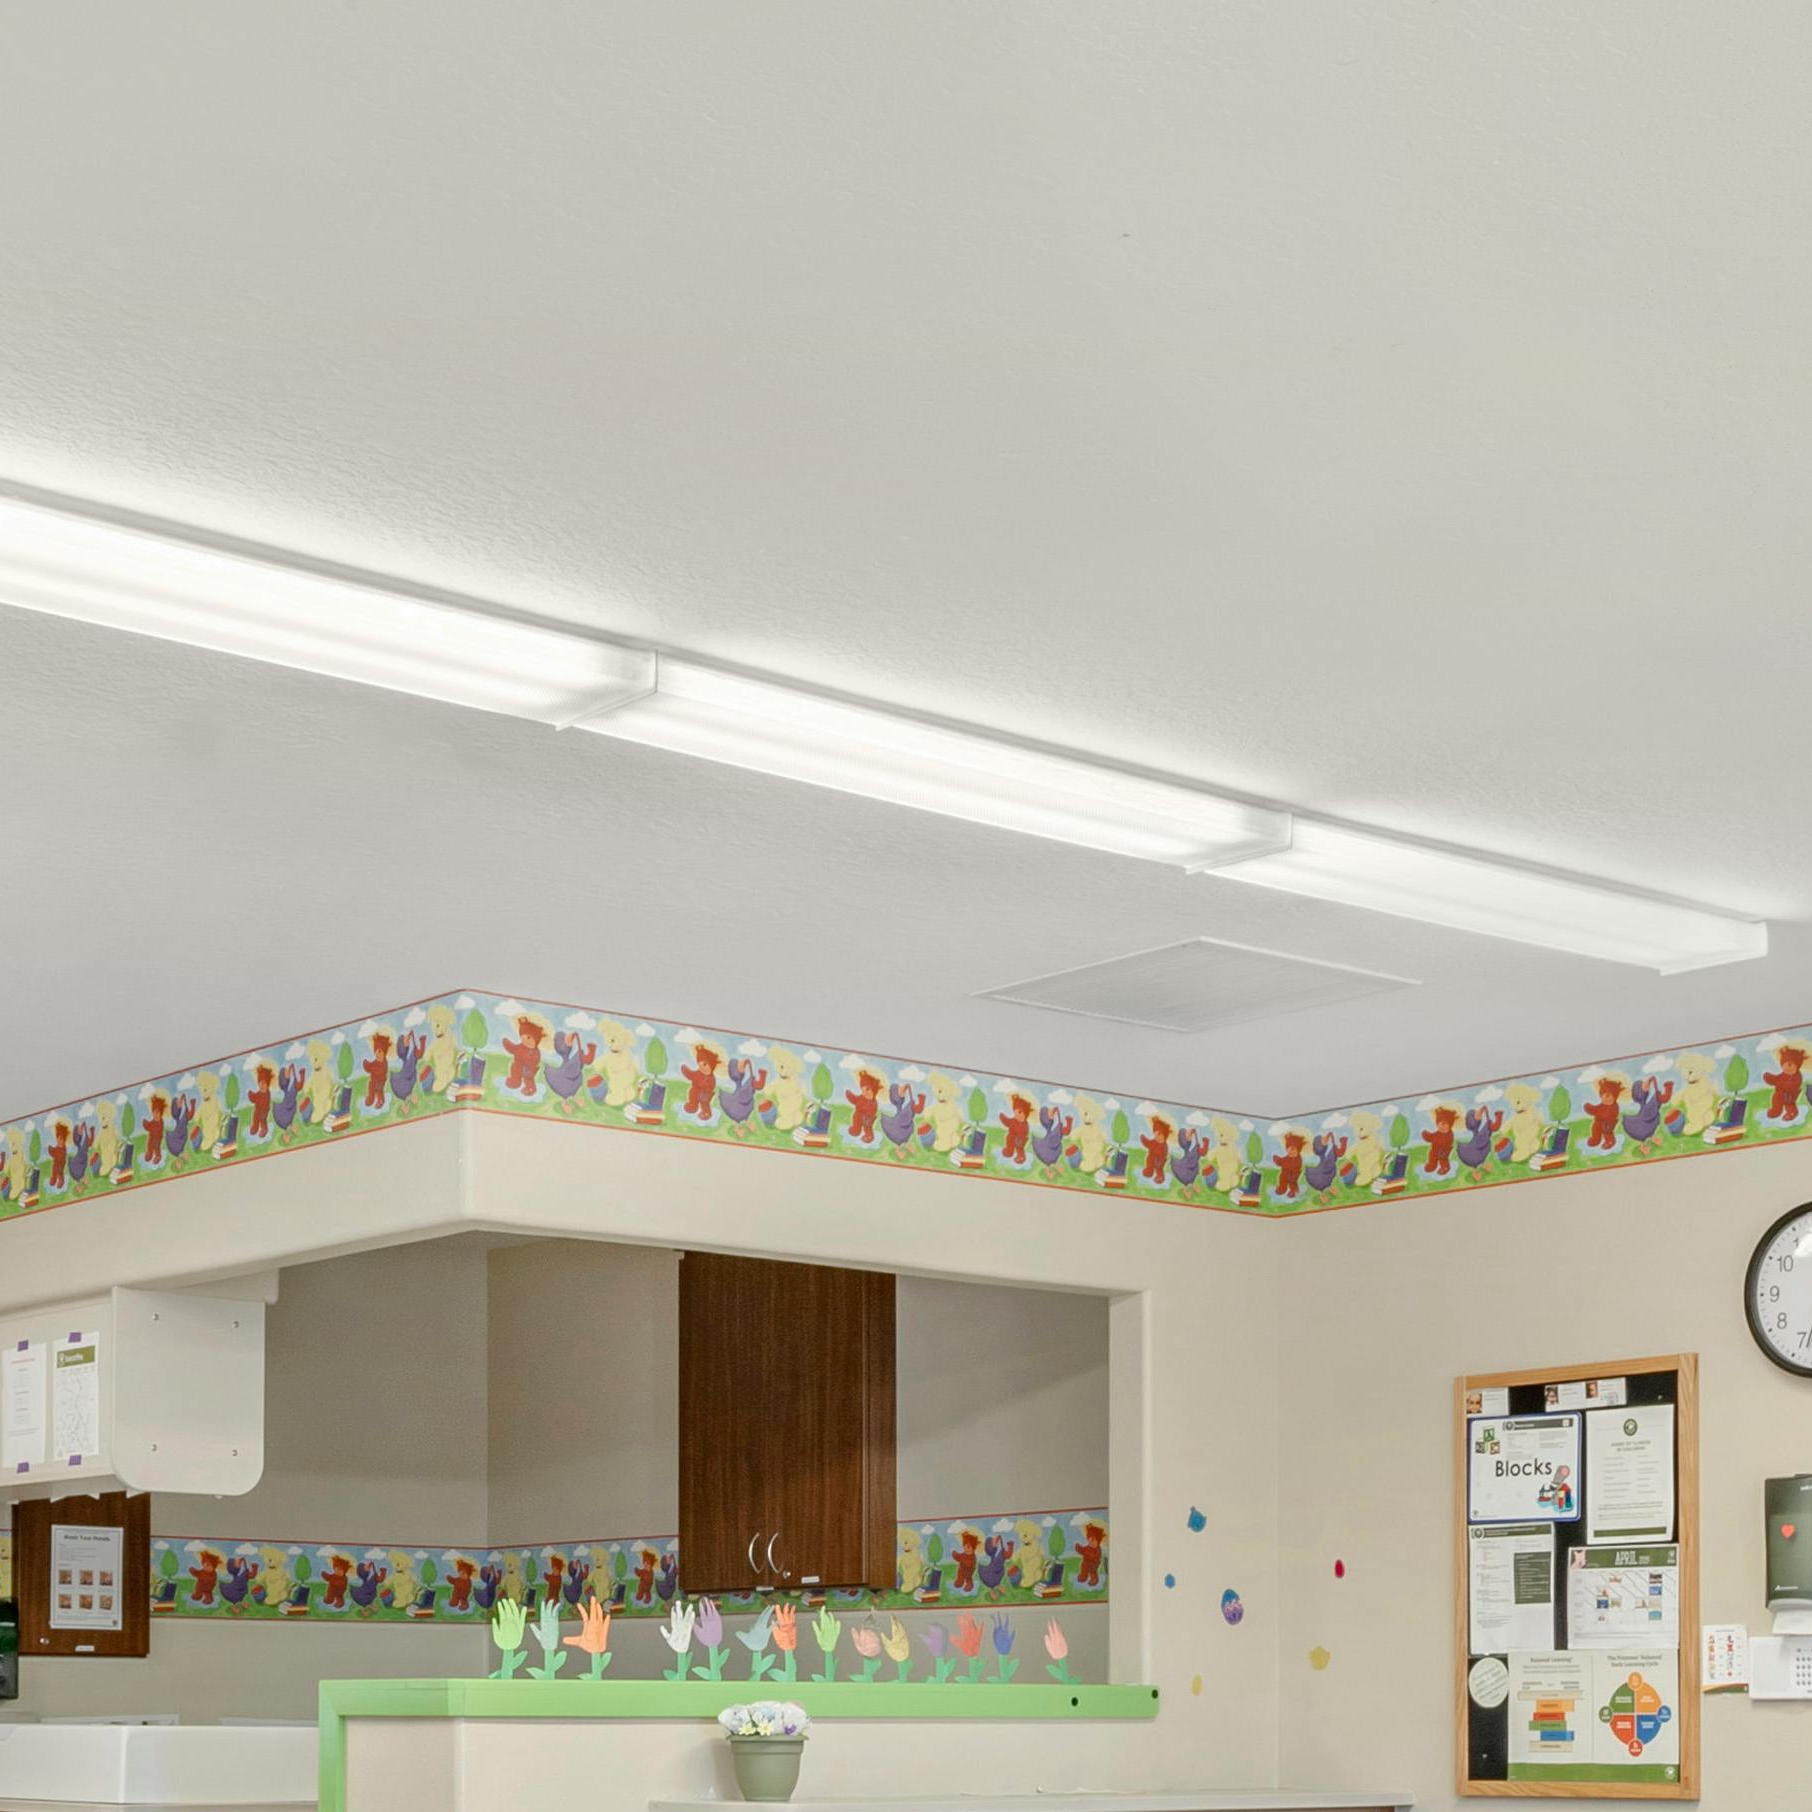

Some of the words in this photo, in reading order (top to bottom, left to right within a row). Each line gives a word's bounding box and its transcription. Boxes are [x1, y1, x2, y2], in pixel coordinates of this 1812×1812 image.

[1777, 1255, 1793, 1272] 10
[1769, 1286, 1780, 1302] 9
[1777, 1313, 1787, 1329] 8
[1797, 1332, 1807, 1349] 7
[1495, 1458, 1553, 1477] Blocks
